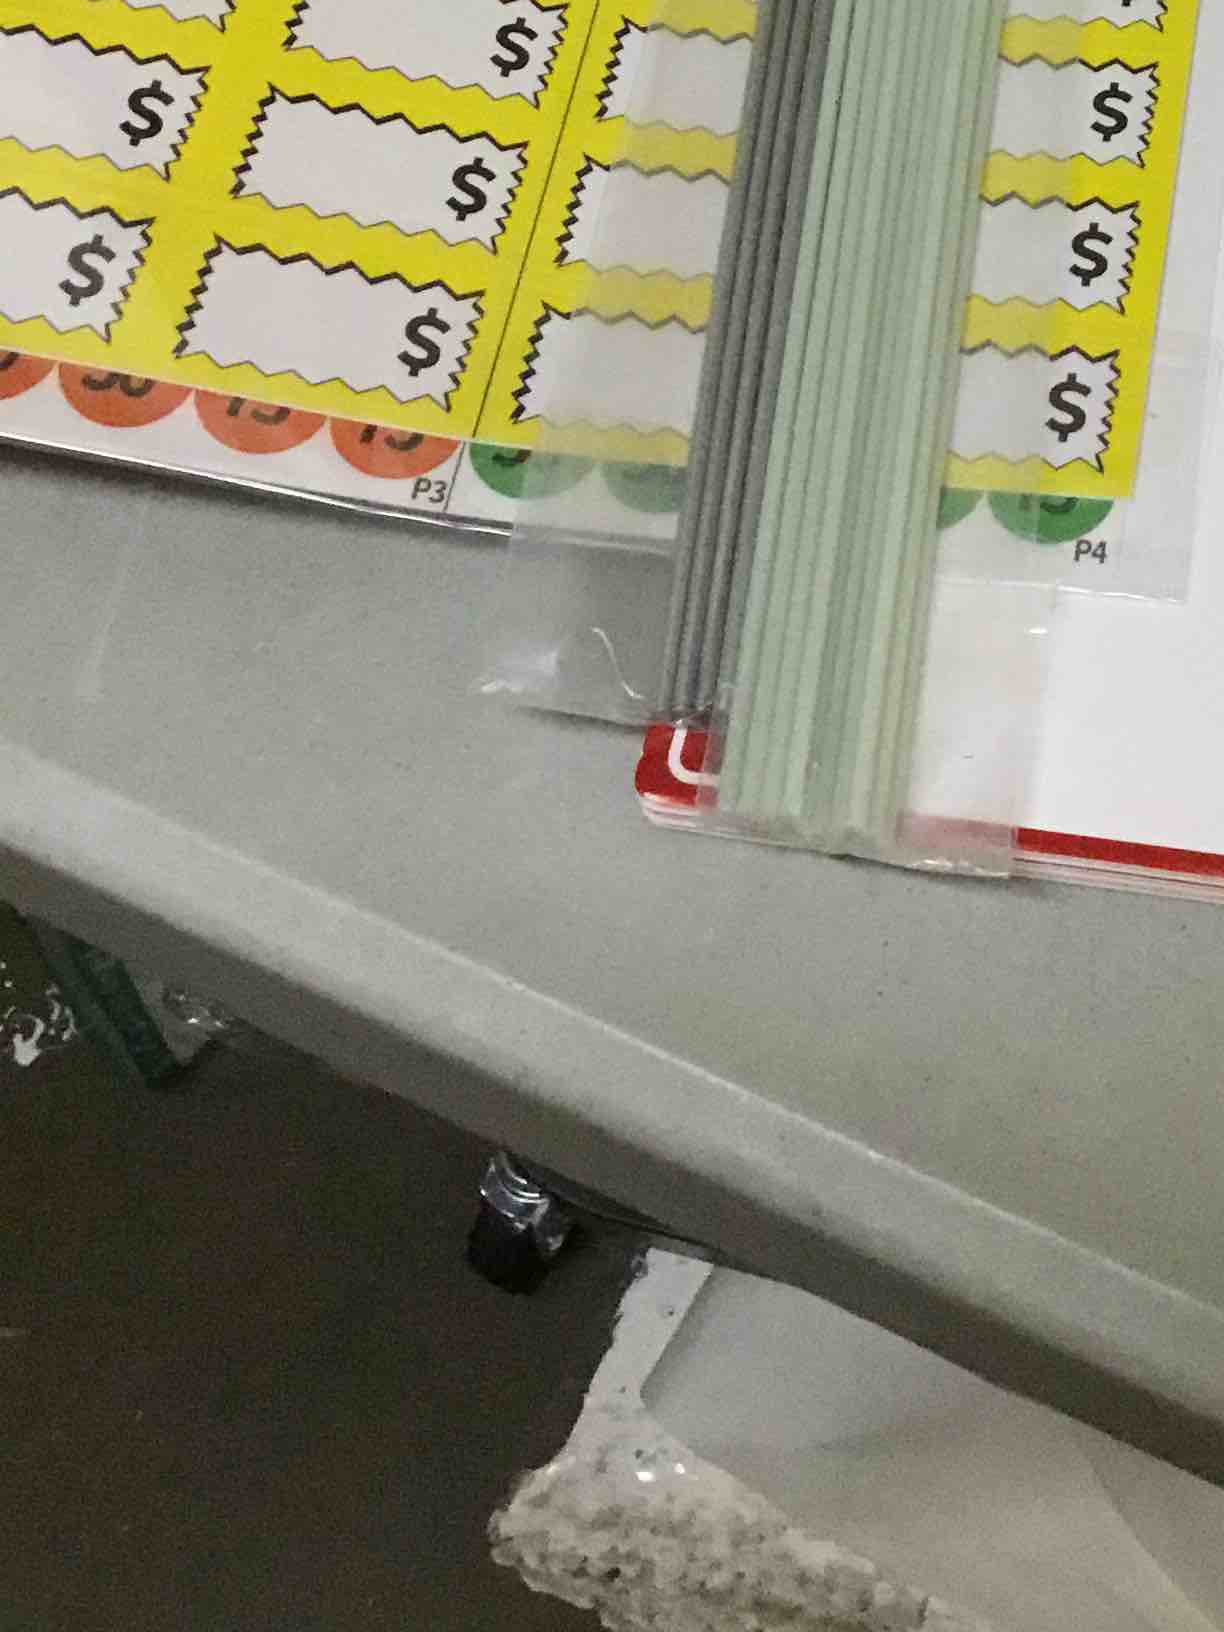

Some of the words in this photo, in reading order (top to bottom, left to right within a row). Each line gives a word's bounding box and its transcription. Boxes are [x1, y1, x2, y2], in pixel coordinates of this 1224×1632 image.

[490, 16, 539, 78] $
[119, 79, 175, 147] $
[1090, 82, 1133, 143] $
[445, 156, 497, 222] $
[59, 234, 116, 307] $
[1069, 222, 1113, 287] $
[397, 307, 451, 378] $
[1045, 372, 1092, 443] $
[411, 477, 448, 504] P3
[1073, 538, 1108, 564] P4
